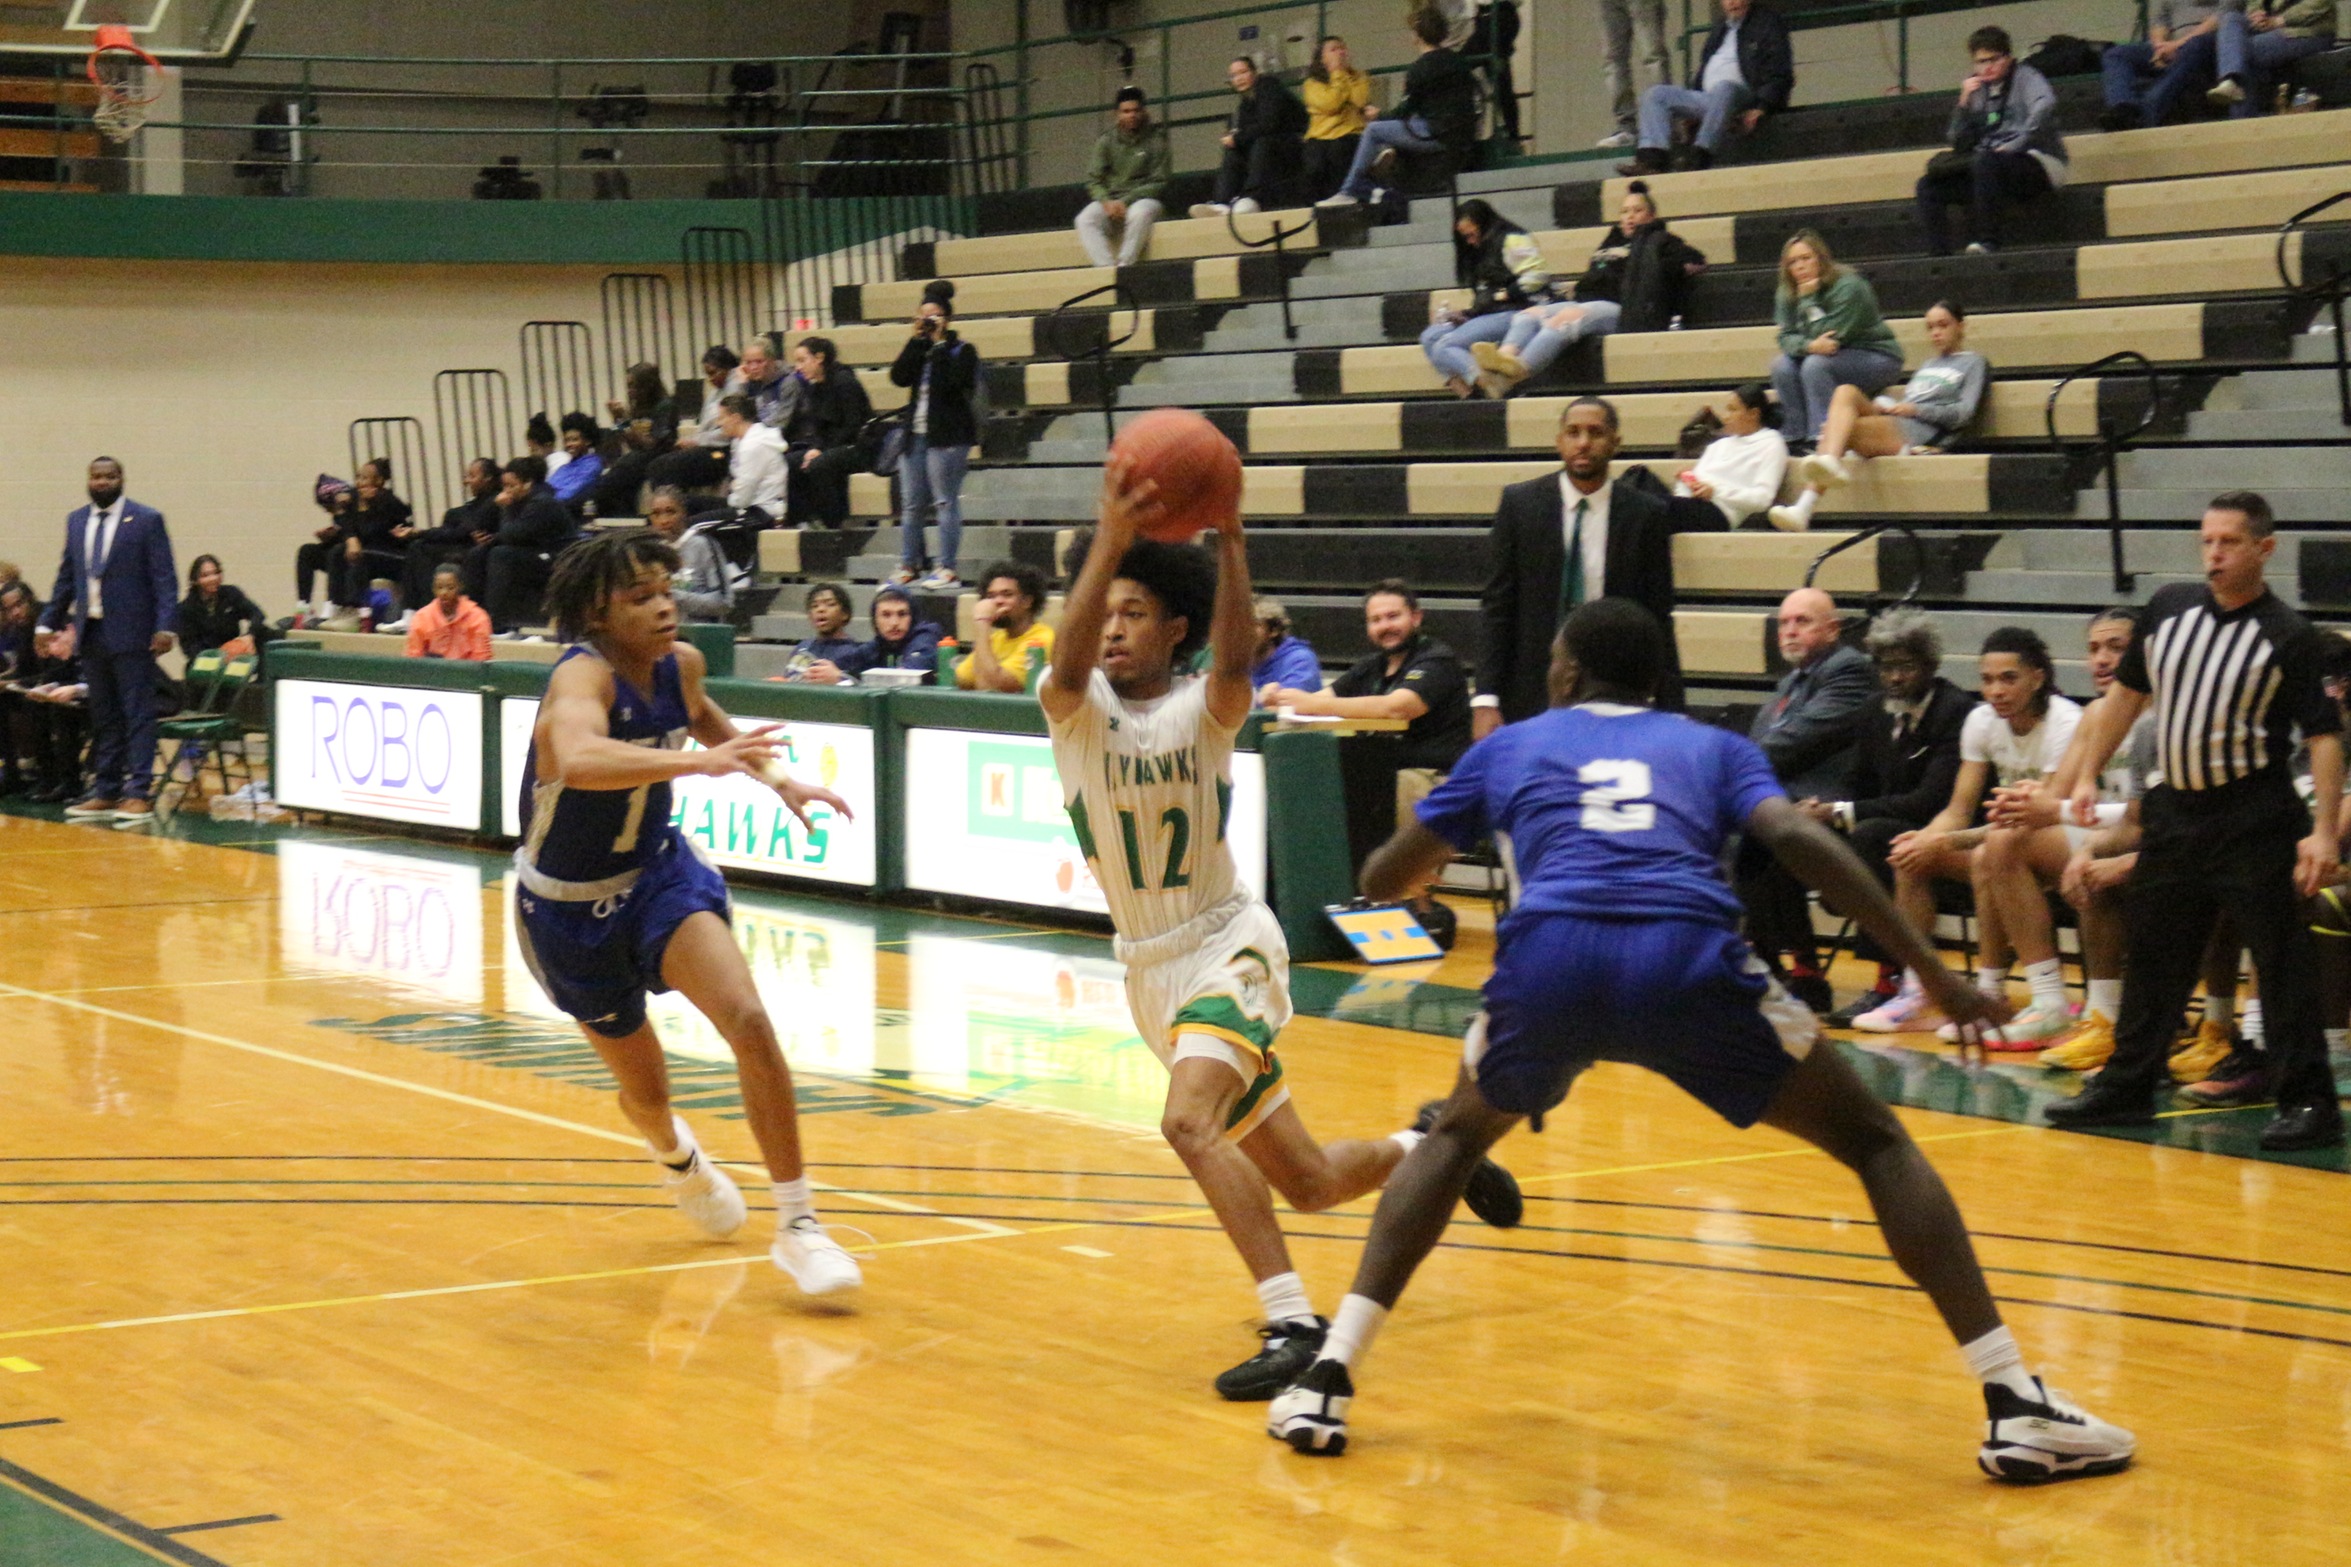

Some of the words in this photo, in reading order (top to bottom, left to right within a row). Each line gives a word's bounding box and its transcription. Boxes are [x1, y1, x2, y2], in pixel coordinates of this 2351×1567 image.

[312, 695, 451, 795] ROBO
[610, 783, 650, 854] 1
[1578, 759, 1656, 832] 2
[1117, 805, 1192, 890] 12
